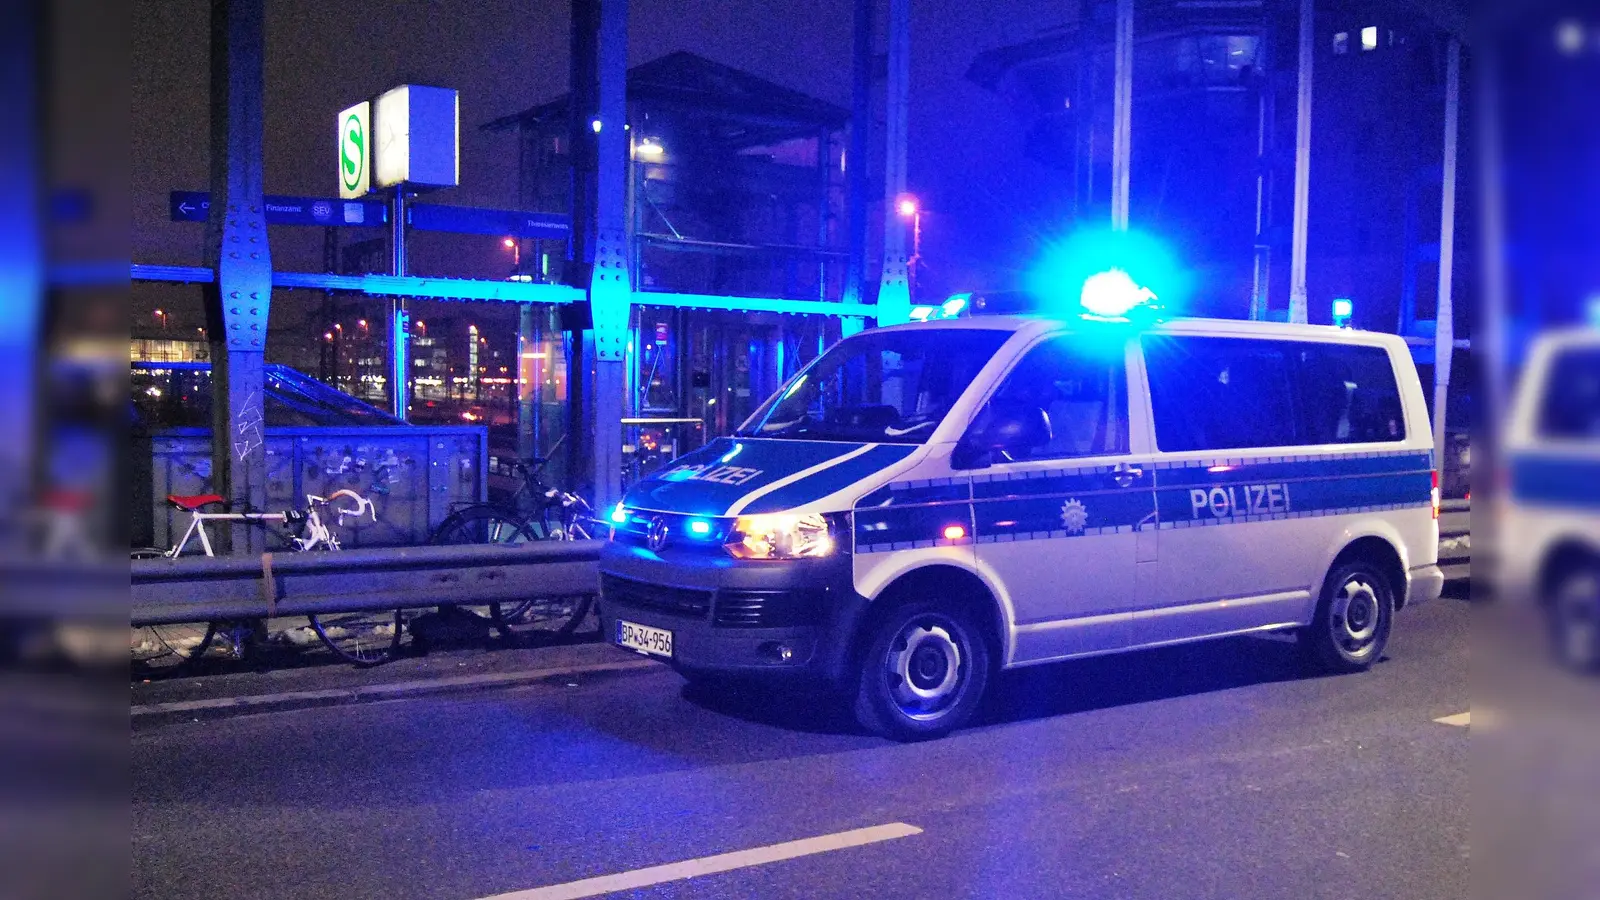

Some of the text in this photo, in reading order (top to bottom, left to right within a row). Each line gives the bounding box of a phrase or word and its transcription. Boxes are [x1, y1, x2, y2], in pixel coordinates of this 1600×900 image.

[342, 114, 364, 191] S
[266, 204, 331, 215] Finanzamt SEV
[527, 220, 569, 230] Theresienwies
[1190, 483, 1290, 519] POLIZEI
